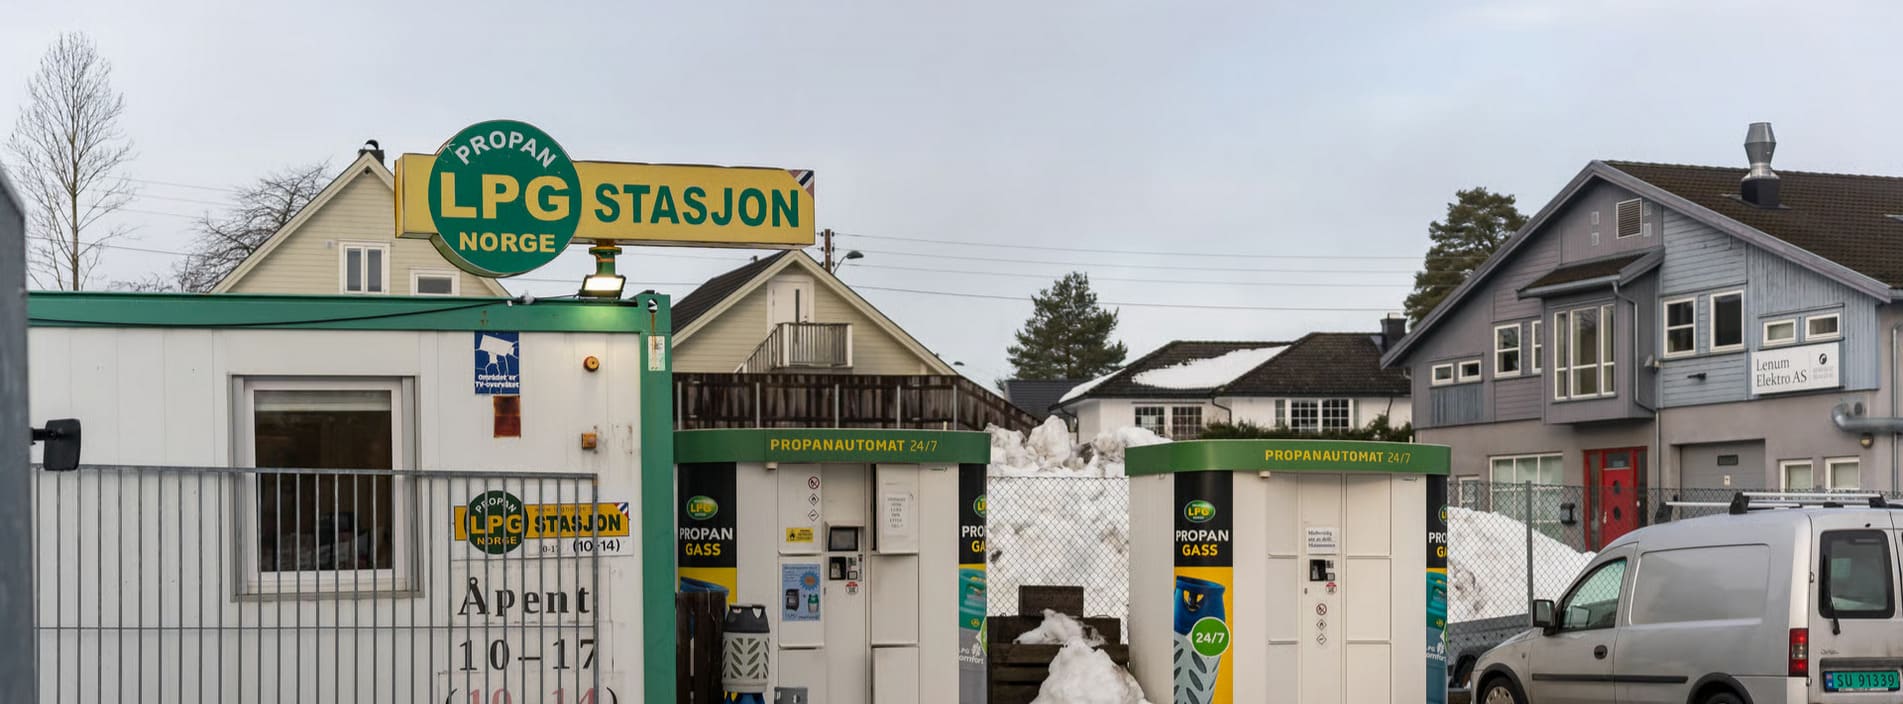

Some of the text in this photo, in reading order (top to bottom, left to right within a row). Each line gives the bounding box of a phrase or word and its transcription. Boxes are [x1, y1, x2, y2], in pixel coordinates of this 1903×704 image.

[454, 130, 557, 168] PROPAN
[440, 171, 800, 229] LPG STASJON
[458, 231, 556, 254] NORGE
[1756, 358, 1790, 372] Lenum
[1756, 373, 1791, 387] Elektro
[1792, 369, 1807, 383] AS
[770, 438, 938, 453] PROPANAUTOMAT 24/7
[1265, 449, 1412, 465] PROPANAUTOMAT 24/7
[1187, 506, 1210, 517] LPG
[470, 514, 621, 535] LPG STASJON
[961, 525, 985, 538] PRO
[679, 527, 733, 540] PROPAN
[1175, 530, 1229, 541] PROPAN
[1428, 532, 1447, 543] PRO
[685, 543, 721, 556] GASS
[971, 540, 986, 553] GA
[1182, 544, 1218, 556] GASS
[457, 576, 590, 617] Åpent
[1196, 631, 1225, 644] 24/7
[1836, 672, 1895, 687] SU 91339
